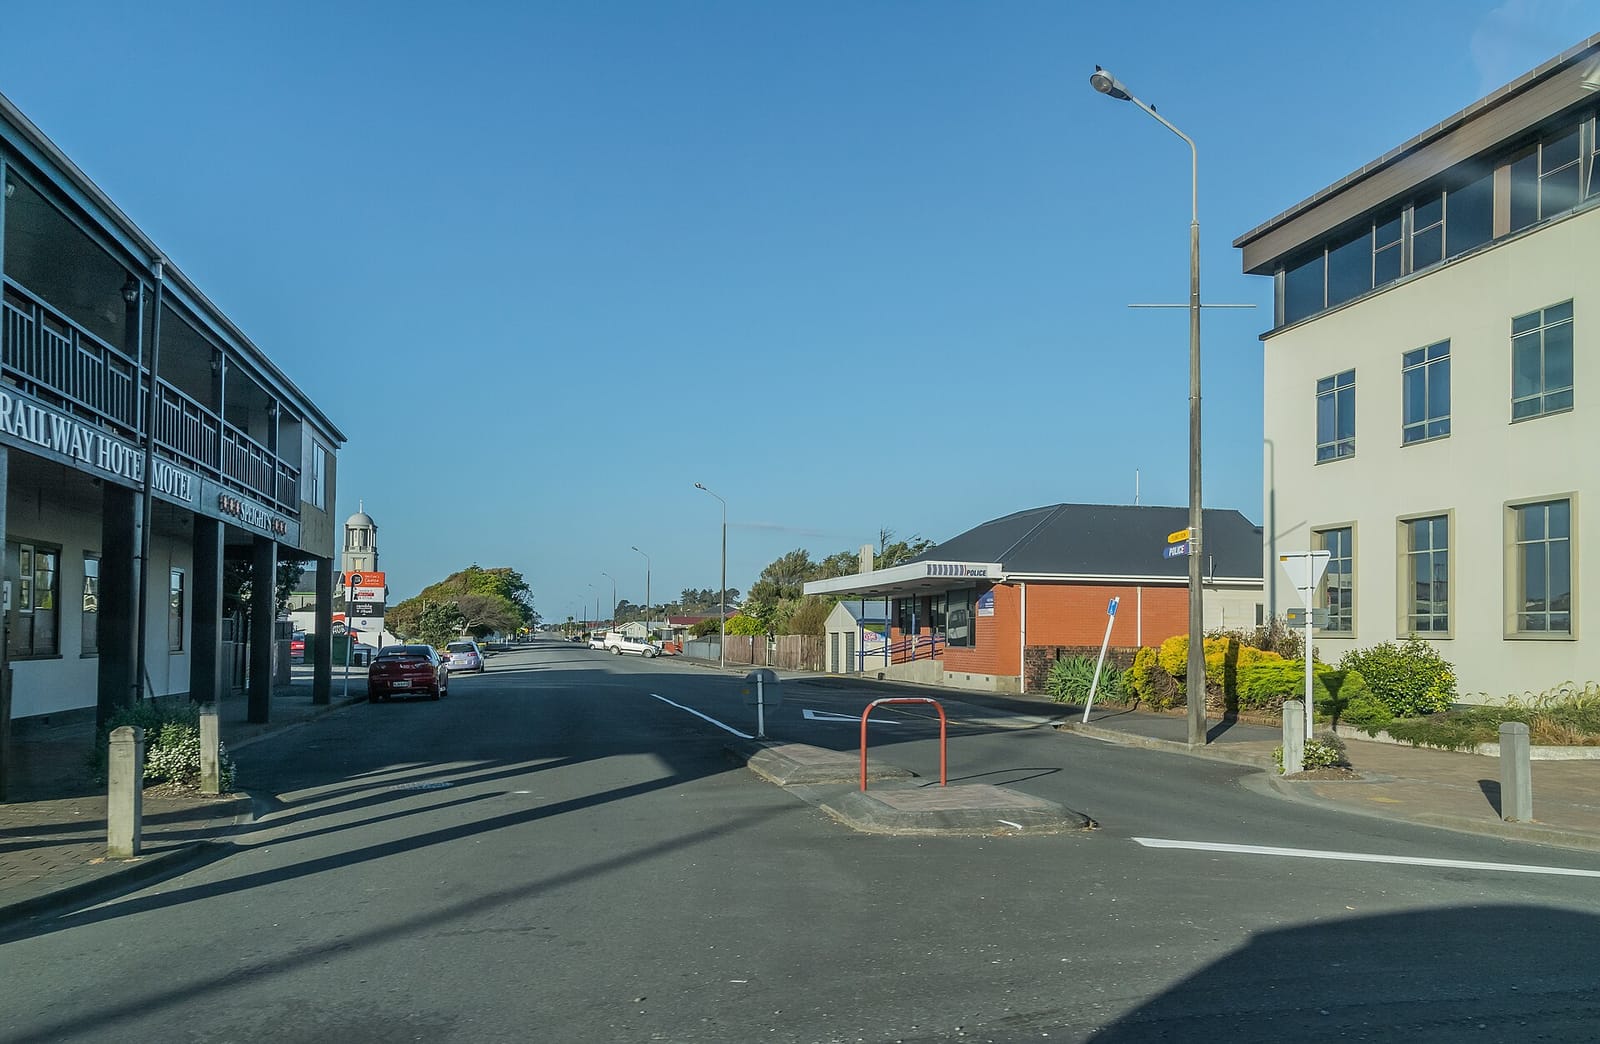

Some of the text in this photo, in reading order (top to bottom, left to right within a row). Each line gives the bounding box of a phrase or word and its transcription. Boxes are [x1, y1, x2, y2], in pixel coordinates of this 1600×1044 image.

[0, 391, 193, 502] RAILWAY HOTE MOTEL
[1168, 544, 1185, 557] POLICE
[966, 569, 987, 577] POLICE
